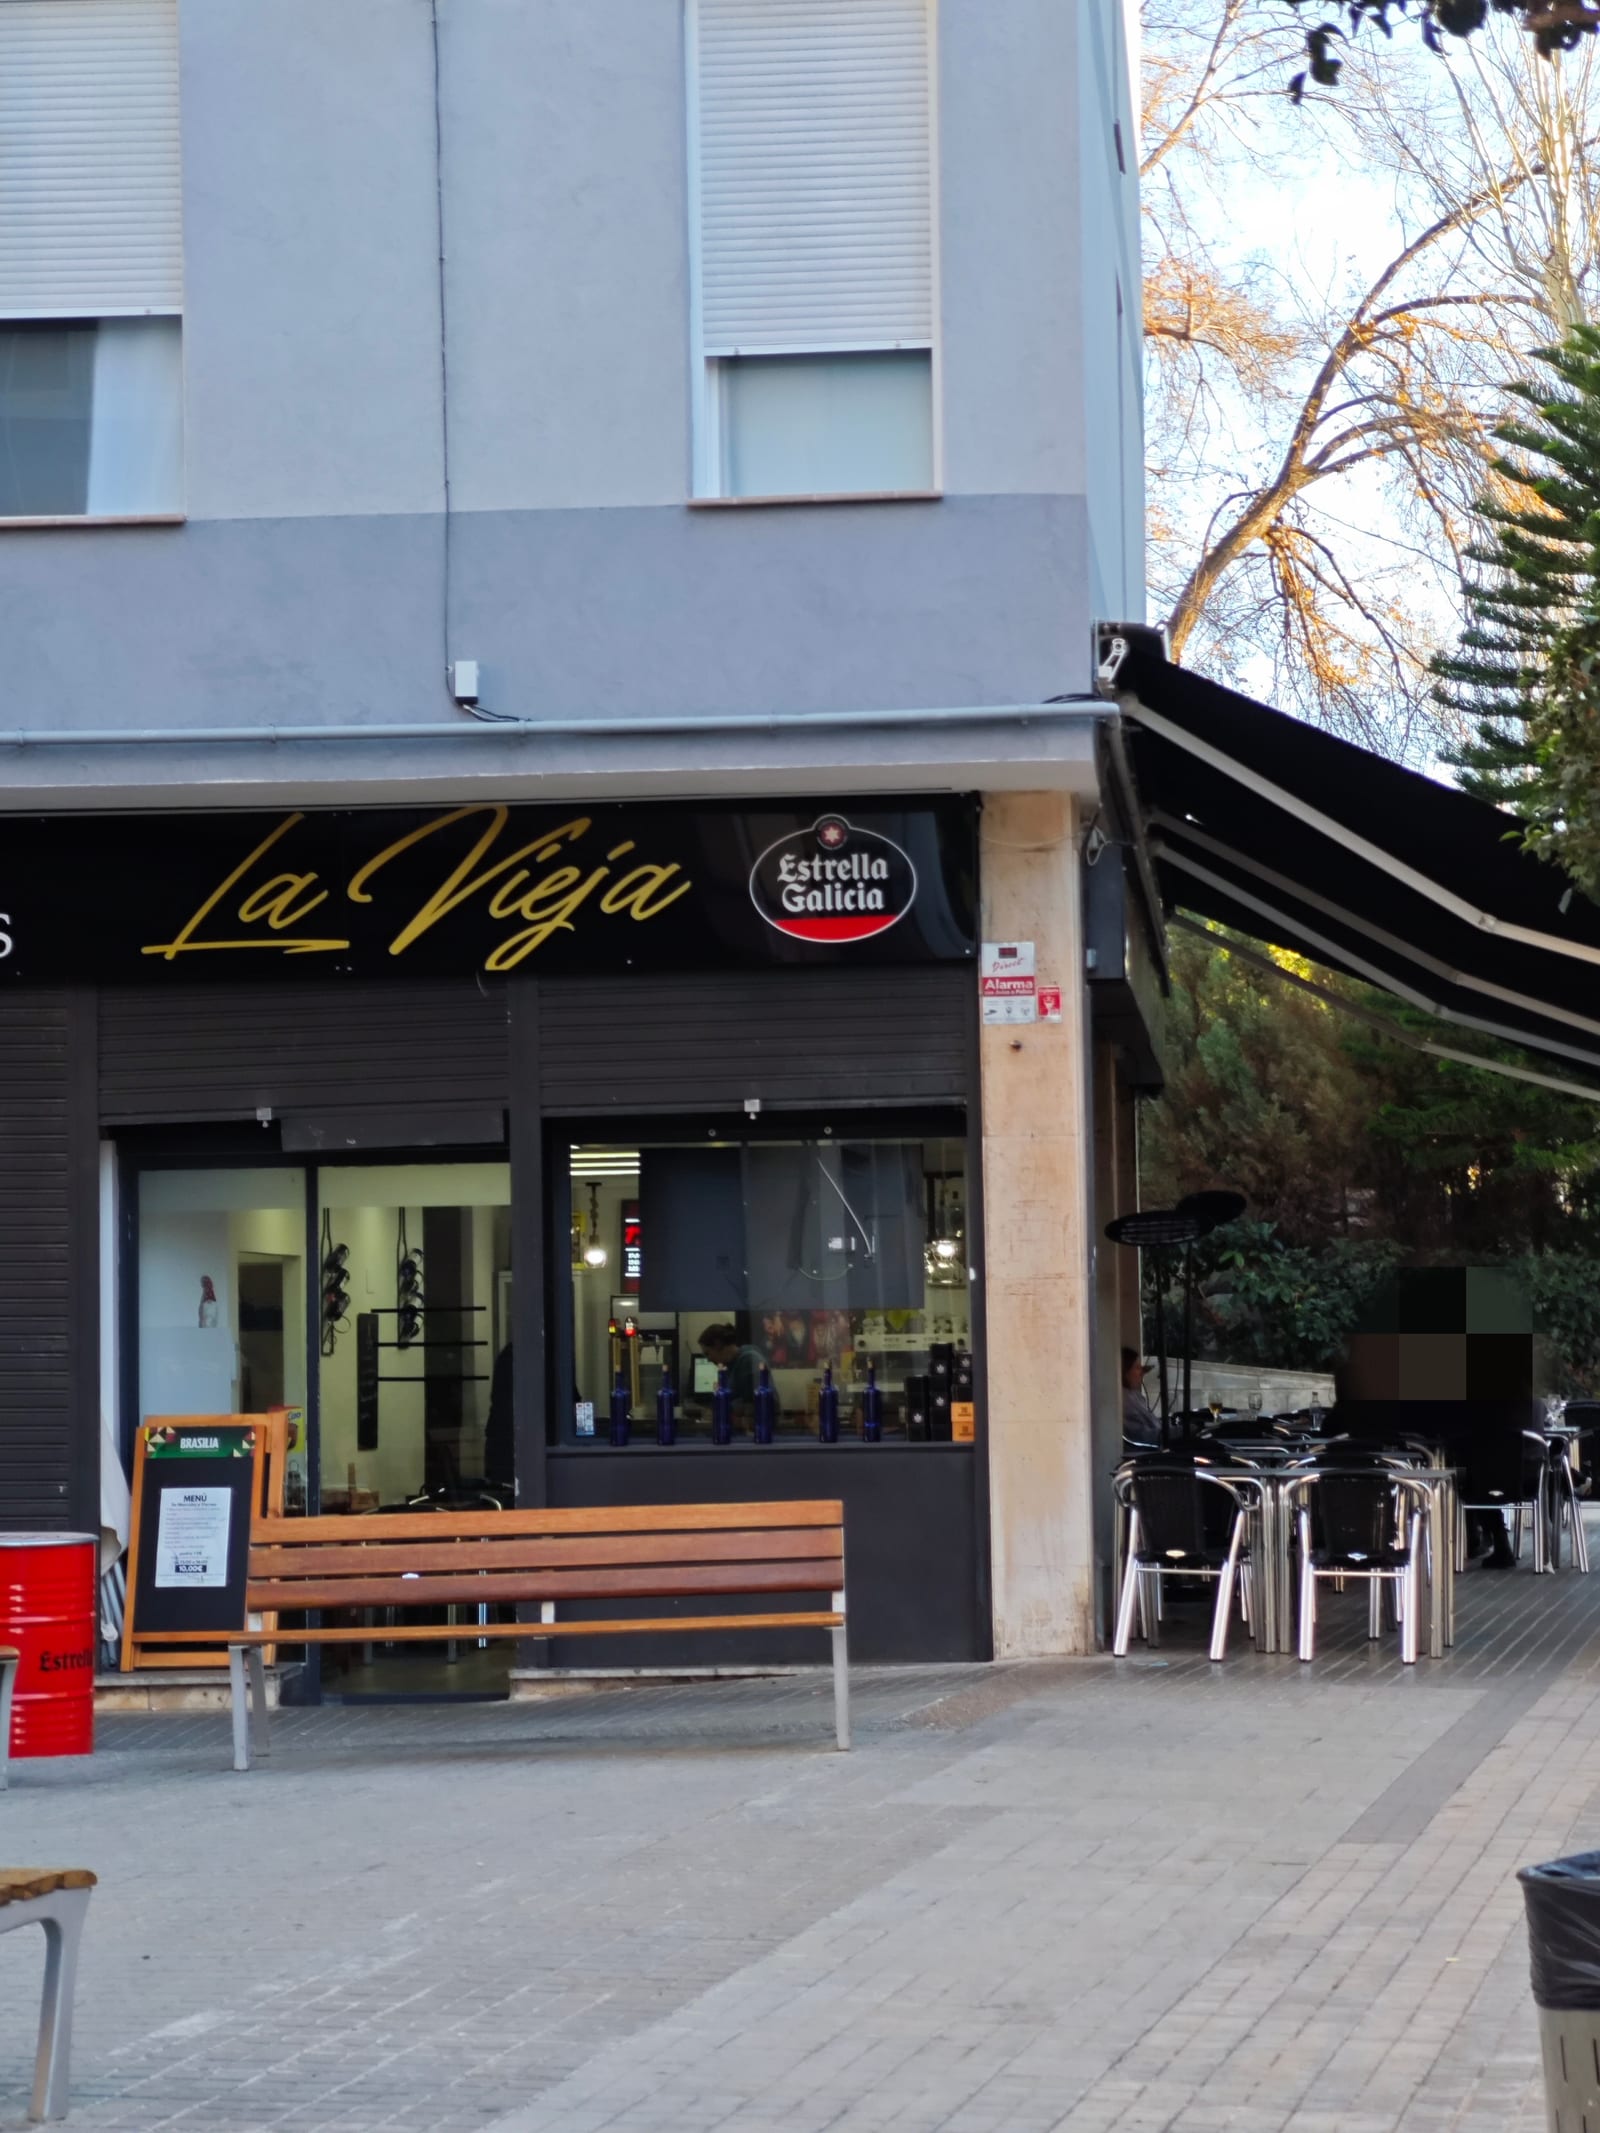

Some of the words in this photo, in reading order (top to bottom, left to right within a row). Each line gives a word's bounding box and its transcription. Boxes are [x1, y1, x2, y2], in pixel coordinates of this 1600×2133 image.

[777, 853, 889, 882] Estrella
[141, 812, 350, 960] La
[347, 802, 692, 971] Vieja
[782, 881, 884, 912] Galicia
[984, 978, 1033, 990] Alarma
[180, 1437, 219, 1449] BRASILIA
